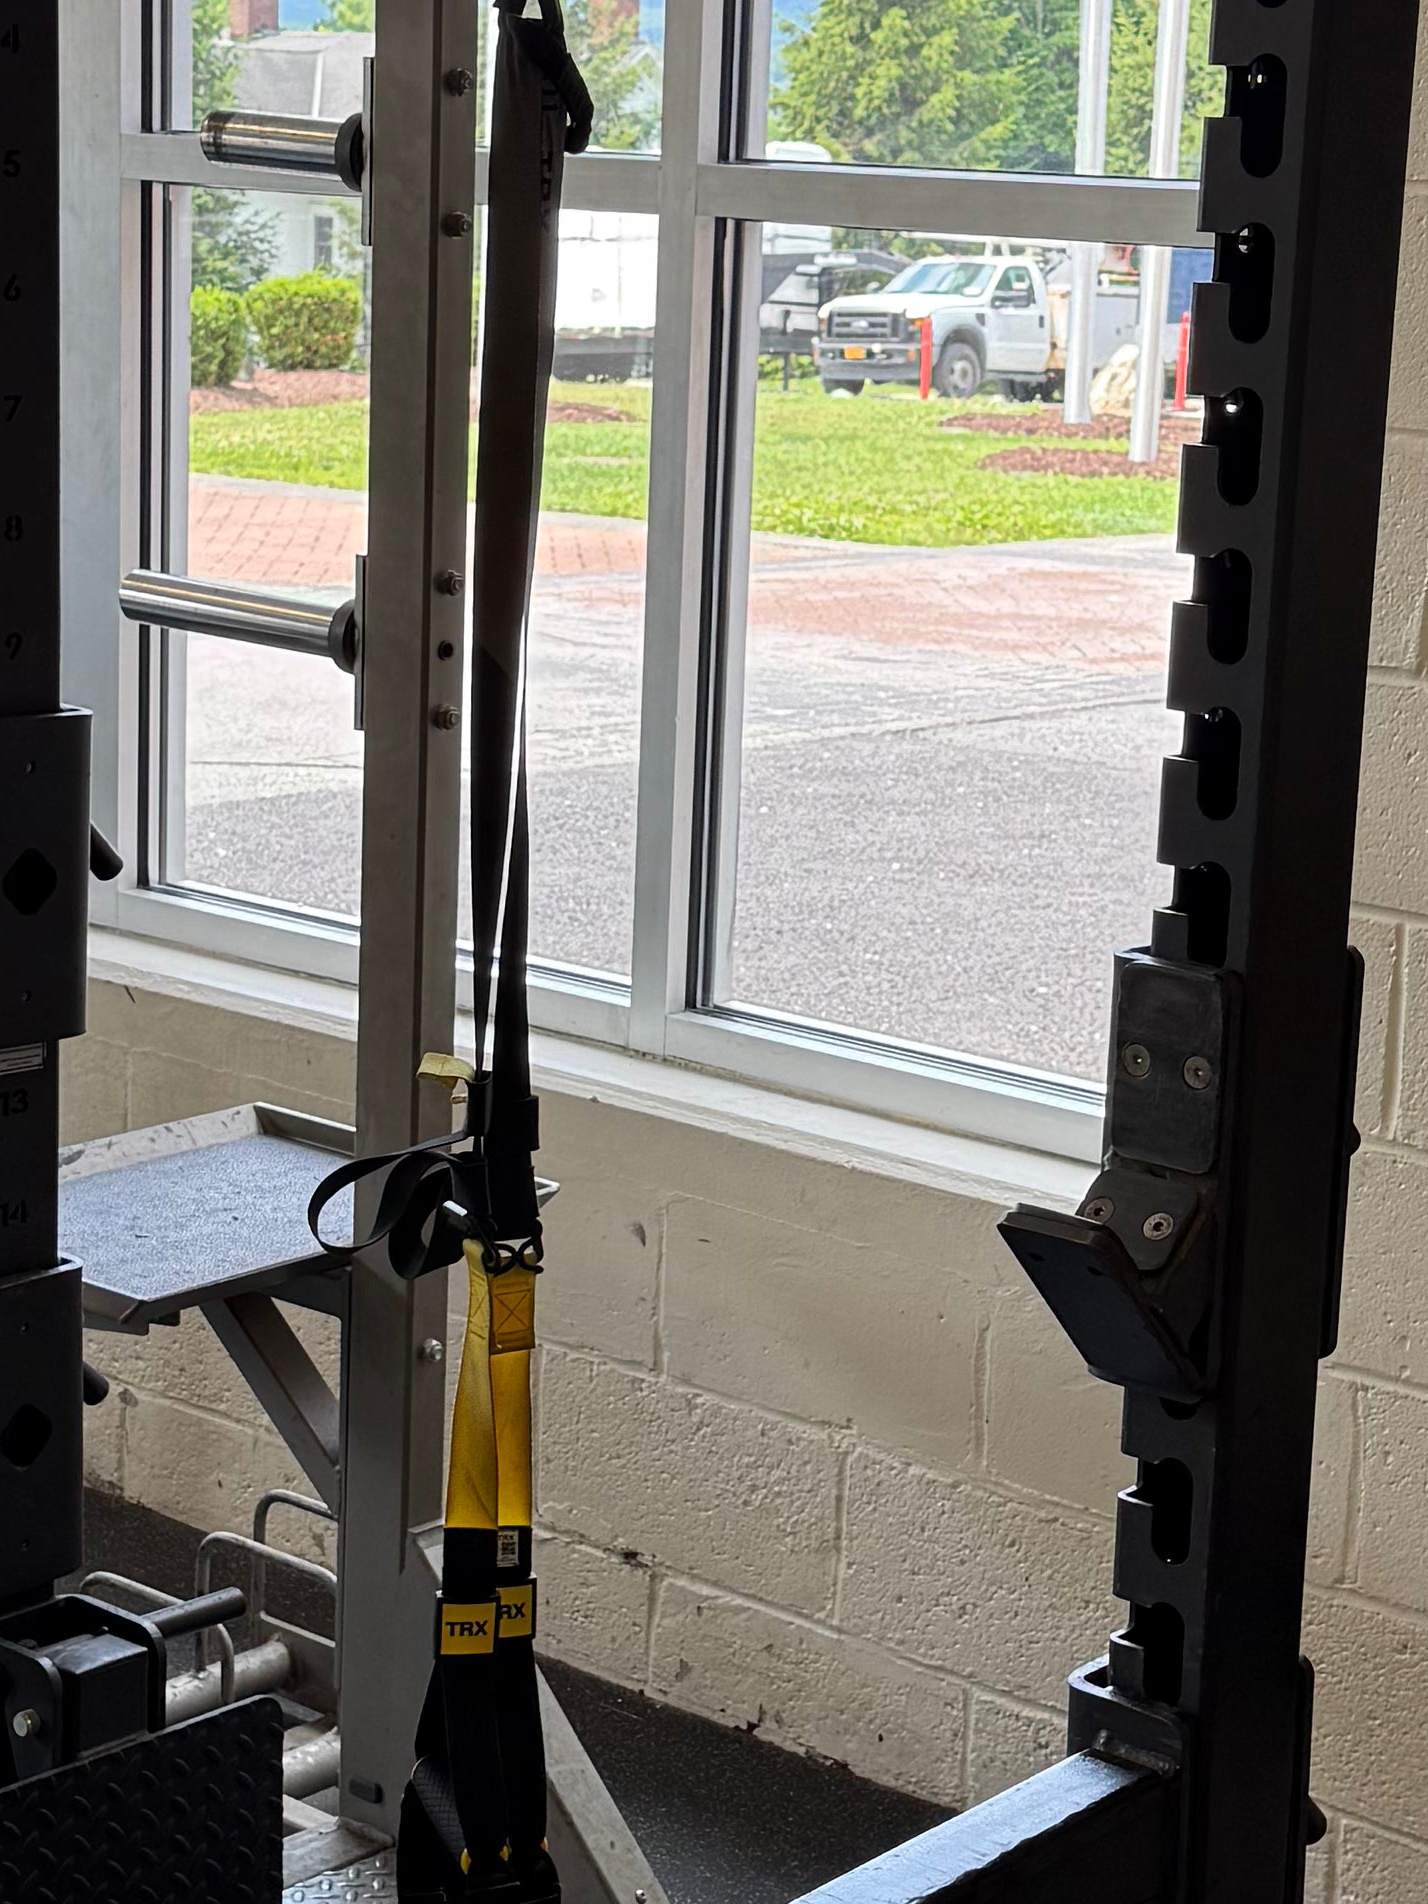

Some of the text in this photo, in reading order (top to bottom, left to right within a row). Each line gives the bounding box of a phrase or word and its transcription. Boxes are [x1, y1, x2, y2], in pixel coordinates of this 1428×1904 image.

[1, 23, 20, 54] 4
[2, 149, 21, 178] 5
[3, 273, 22, 302] 6
[3, 394, 22, 423] 7
[4, 515, 22, 542] 8
[4, 632, 22, 660] 9
[0, 1089, 29, 1117] 13
[498, 1602, 526, 1620] RX
[445, 1620, 489, 1637] TRX
